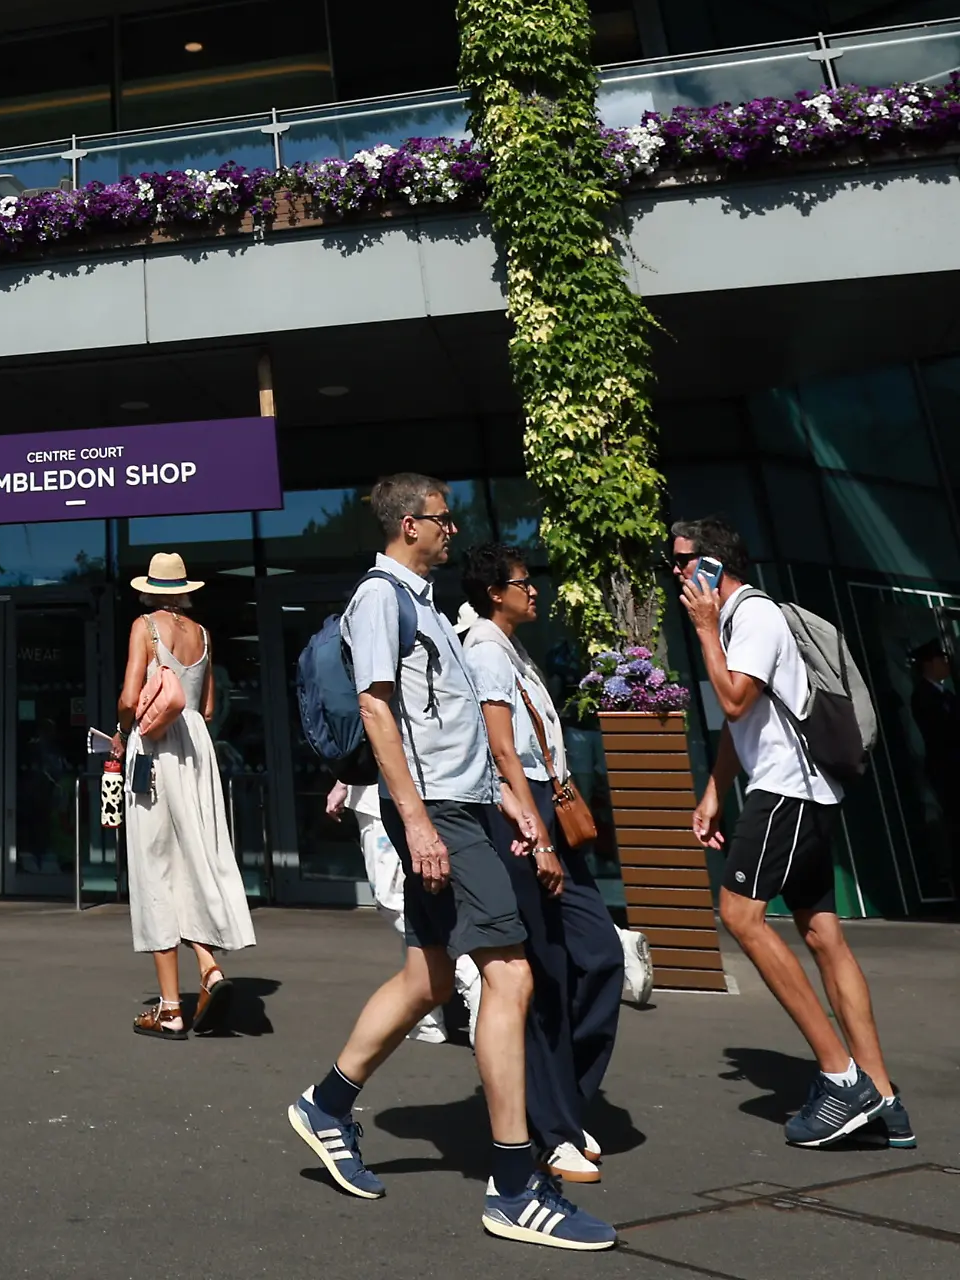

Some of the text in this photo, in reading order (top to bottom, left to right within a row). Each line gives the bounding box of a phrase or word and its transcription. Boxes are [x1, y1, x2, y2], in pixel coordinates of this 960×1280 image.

[26, 446, 124, 463] CENTRE COURT
[125, 461, 197, 486] SHOP
